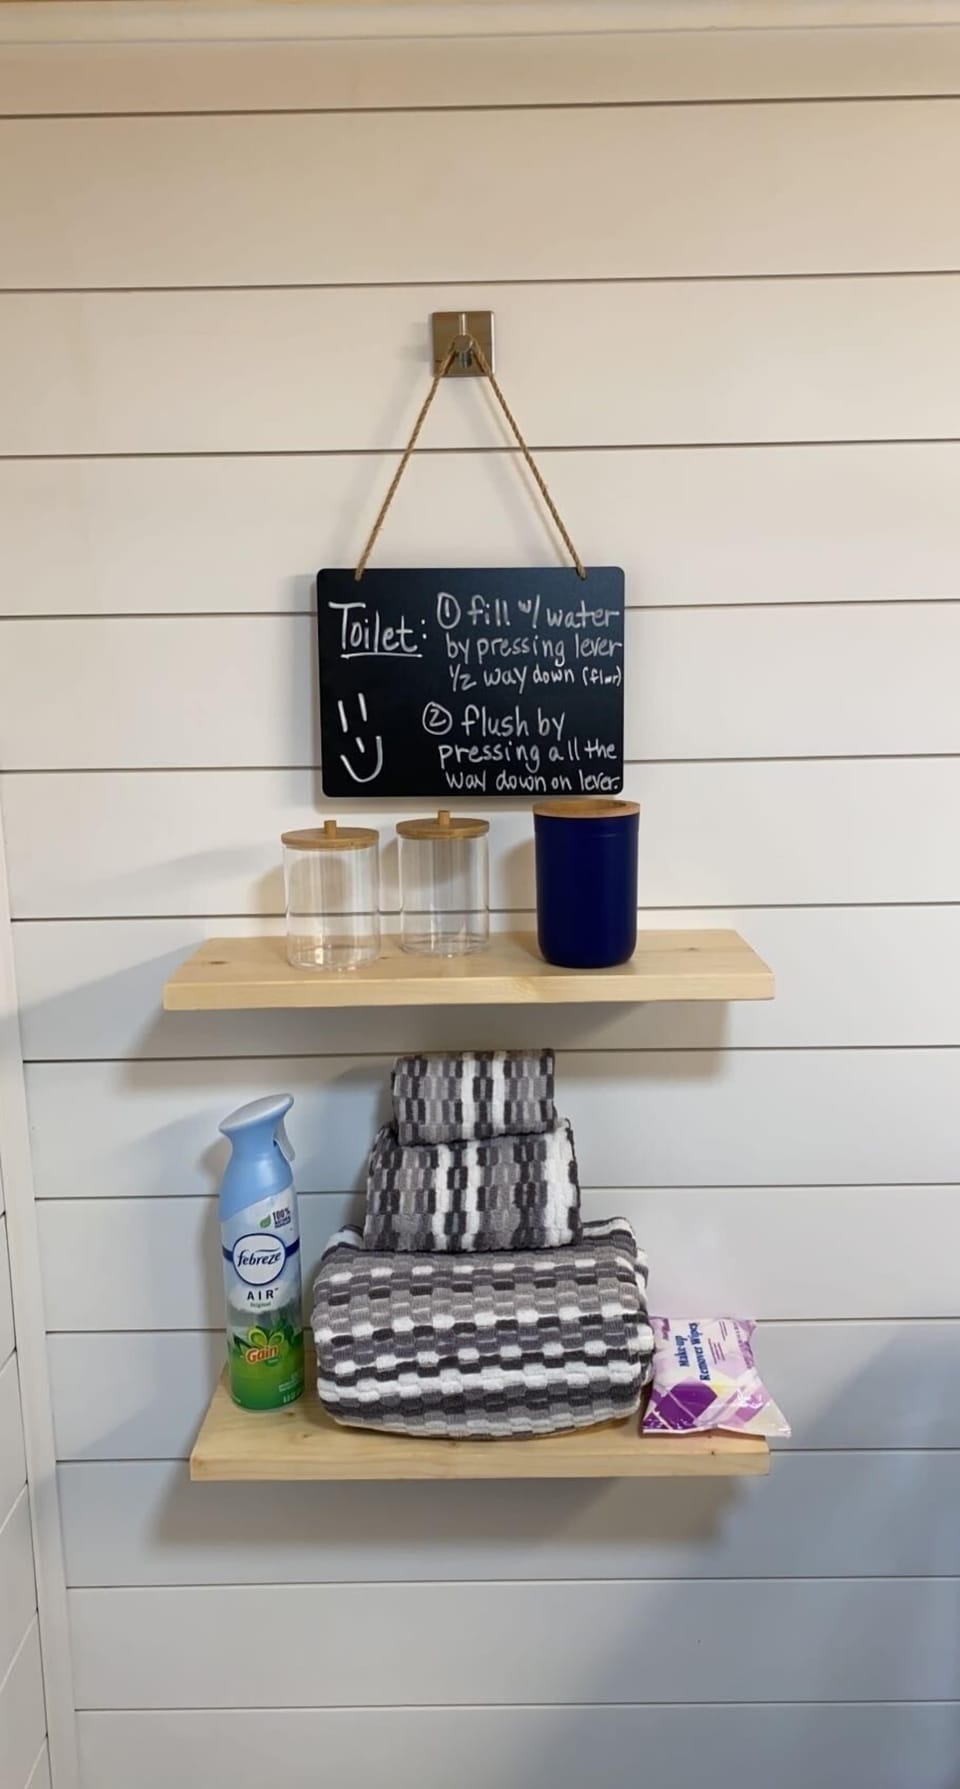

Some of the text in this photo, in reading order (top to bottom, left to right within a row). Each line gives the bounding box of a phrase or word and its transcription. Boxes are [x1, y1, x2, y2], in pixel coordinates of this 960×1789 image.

[329, 601, 427, 653] Toilet:
[467, 594, 511, 627] fill
[517, 594, 541, 629] w/
[546, 600, 621, 629] water
[445, 632, 623, 668] by pressing lever
[484, 665, 528, 694] way
[532, 663, 575, 684] down
[461, 704, 529, 737] flush
[537, 707, 565, 741] by
[438, 737, 617, 773] pressing all the
[445, 769, 621, 792] way down on lever.
[236, 1248, 283, 1268] febreze
[246, 1345, 279, 1365] Gain
[688, 1322, 711, 1381] Remover Wipes
